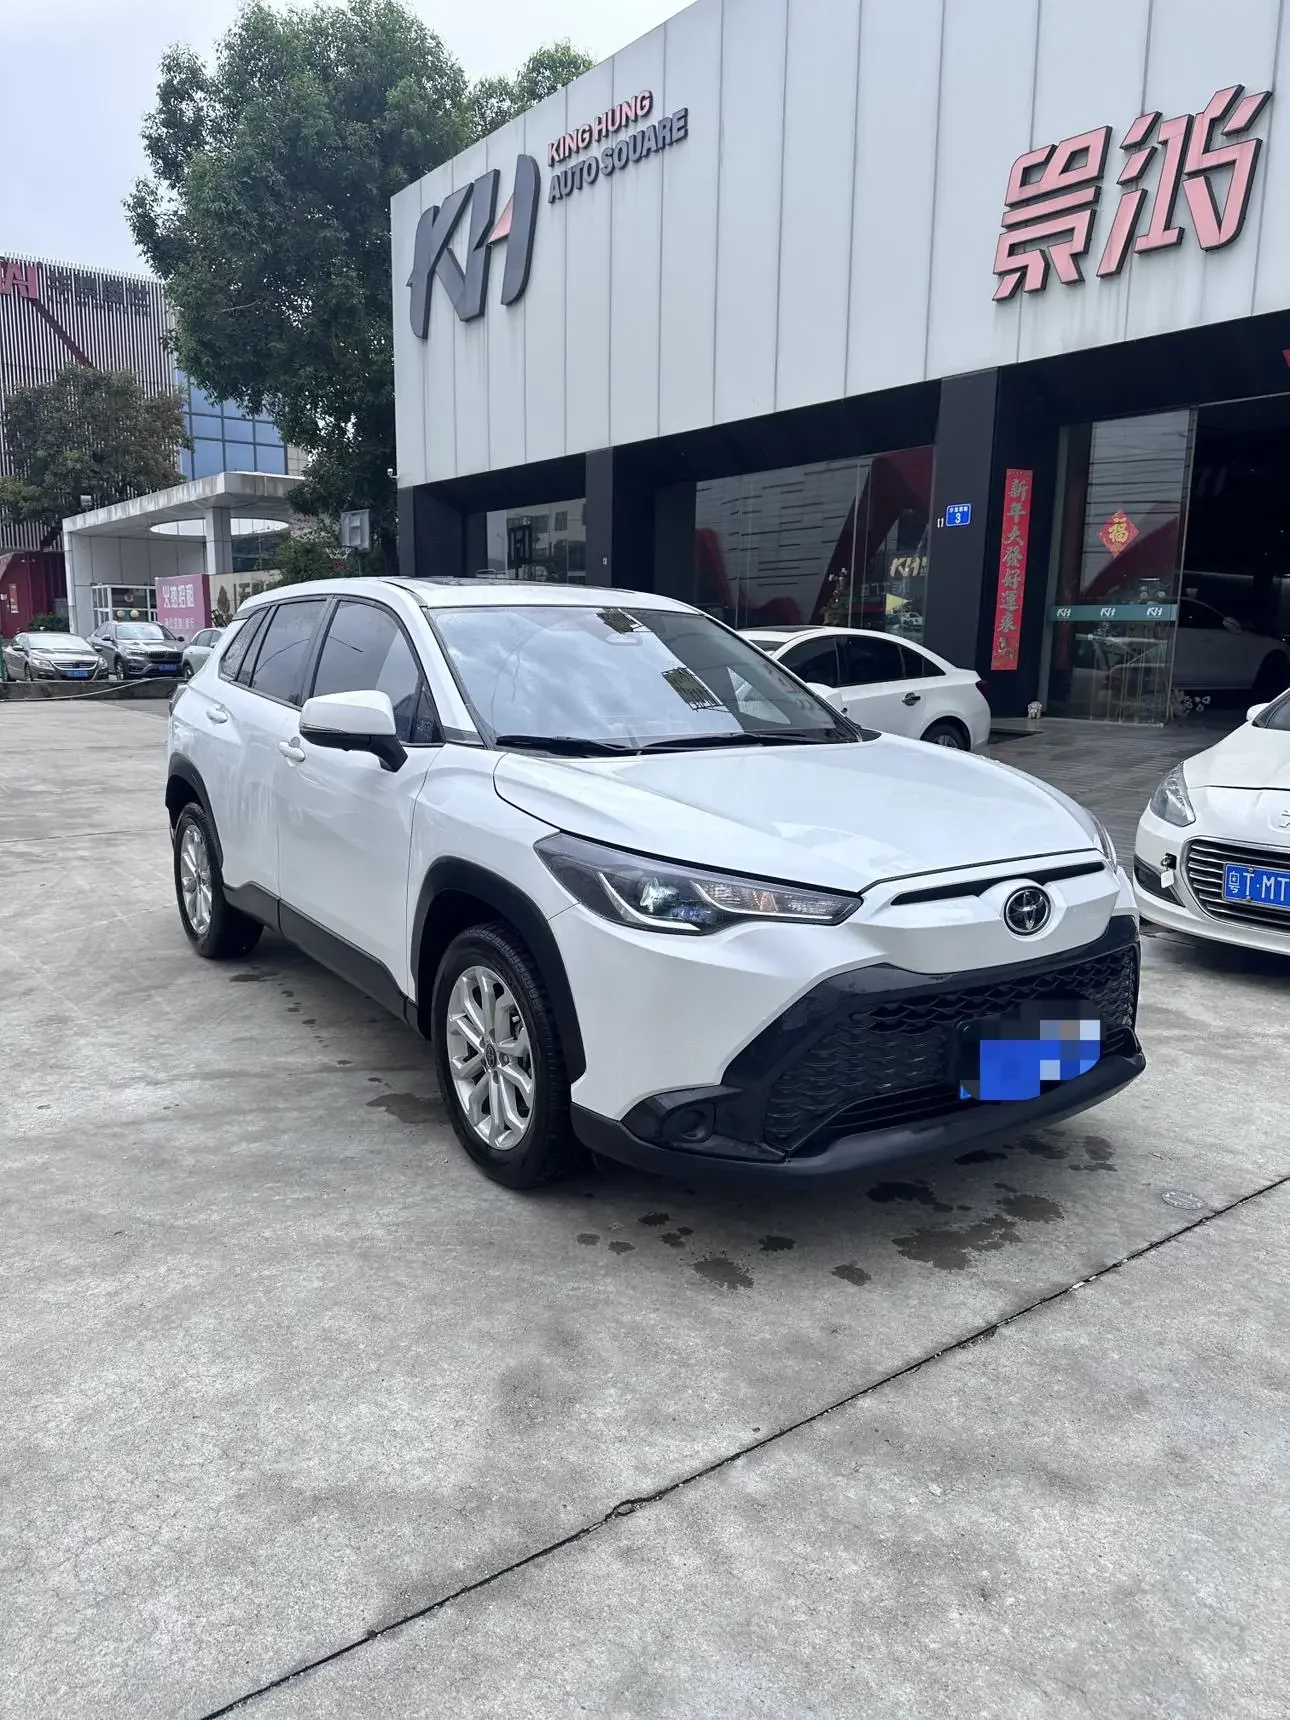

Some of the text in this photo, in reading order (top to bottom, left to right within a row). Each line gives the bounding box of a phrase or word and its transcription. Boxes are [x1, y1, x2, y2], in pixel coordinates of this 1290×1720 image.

[547, 89, 654, 167] KING HUNG
[548, 155, 599, 204] AUTO
[955, 512, 961, 524] 3
[1108, 517, 1129, 543] 福
